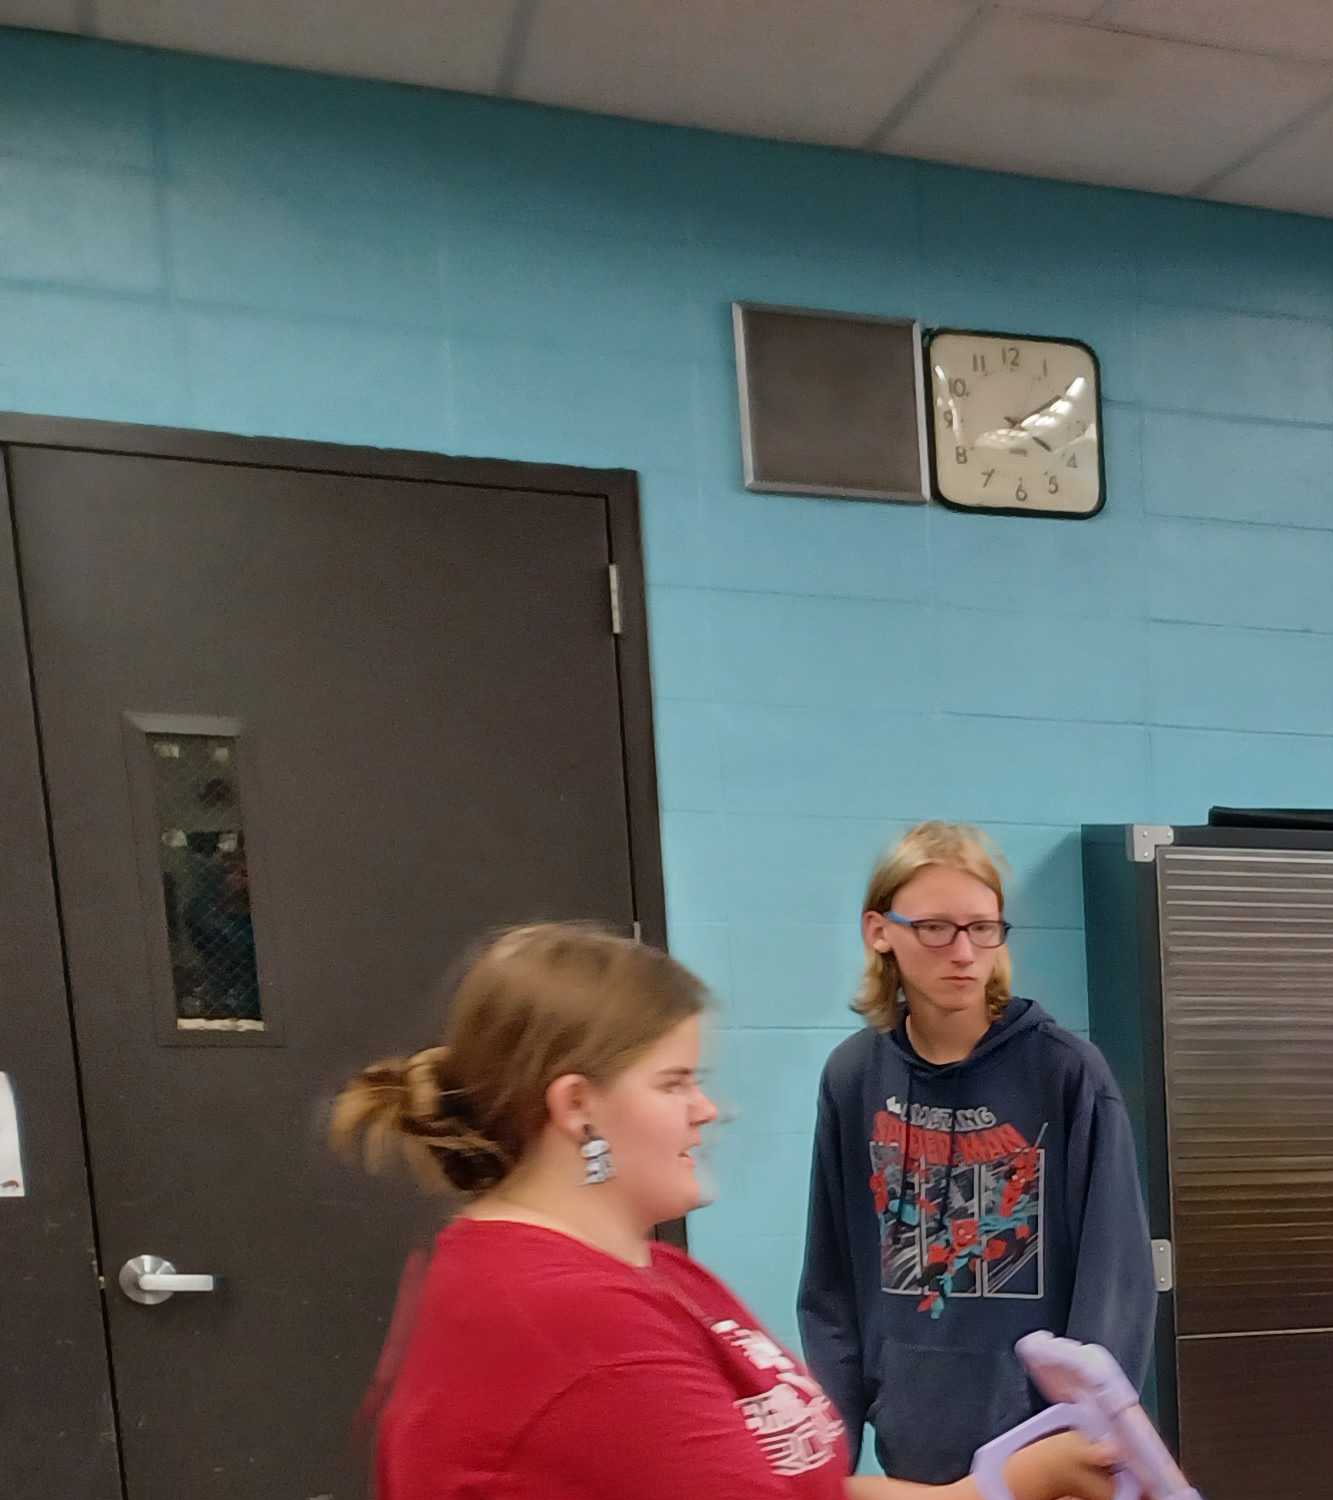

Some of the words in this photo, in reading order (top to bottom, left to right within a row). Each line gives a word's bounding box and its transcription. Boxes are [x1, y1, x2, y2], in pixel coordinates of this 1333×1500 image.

[971, 354, 986, 372] 11
[1001, 347, 1020, 368] 12
[948, 377, 967, 398] 10
[1066, 453, 1078, 469] 4
[980, 468, 996, 488] 7
[1048, 476, 1059, 494] 5
[1015, 482, 1028, 502] 6
